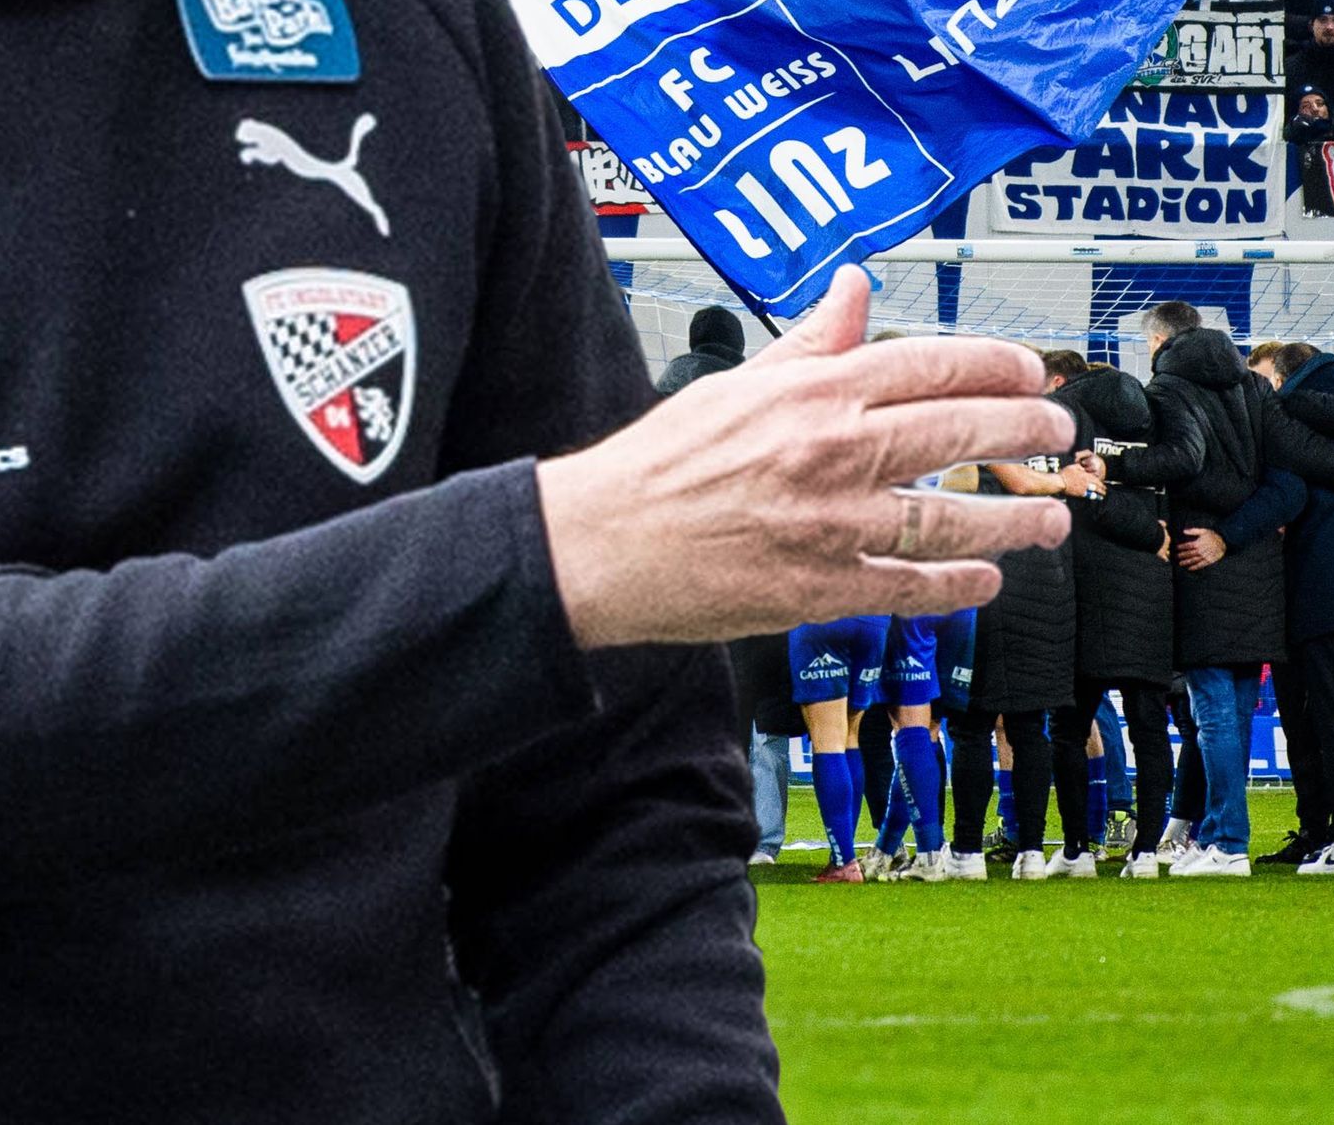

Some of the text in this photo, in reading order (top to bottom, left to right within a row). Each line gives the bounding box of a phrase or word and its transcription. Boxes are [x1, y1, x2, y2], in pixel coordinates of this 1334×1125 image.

[658, 46, 736, 112] FC
[1177, 23, 1286, 77] GART
[632, 114, 723, 185] BLAU
[723, 51, 837, 120] WEISS
[1104, 90, 1270, 128] NAU
[714, 125, 892, 259] LINZ
[294, 324, 402, 407] SCHANZER
